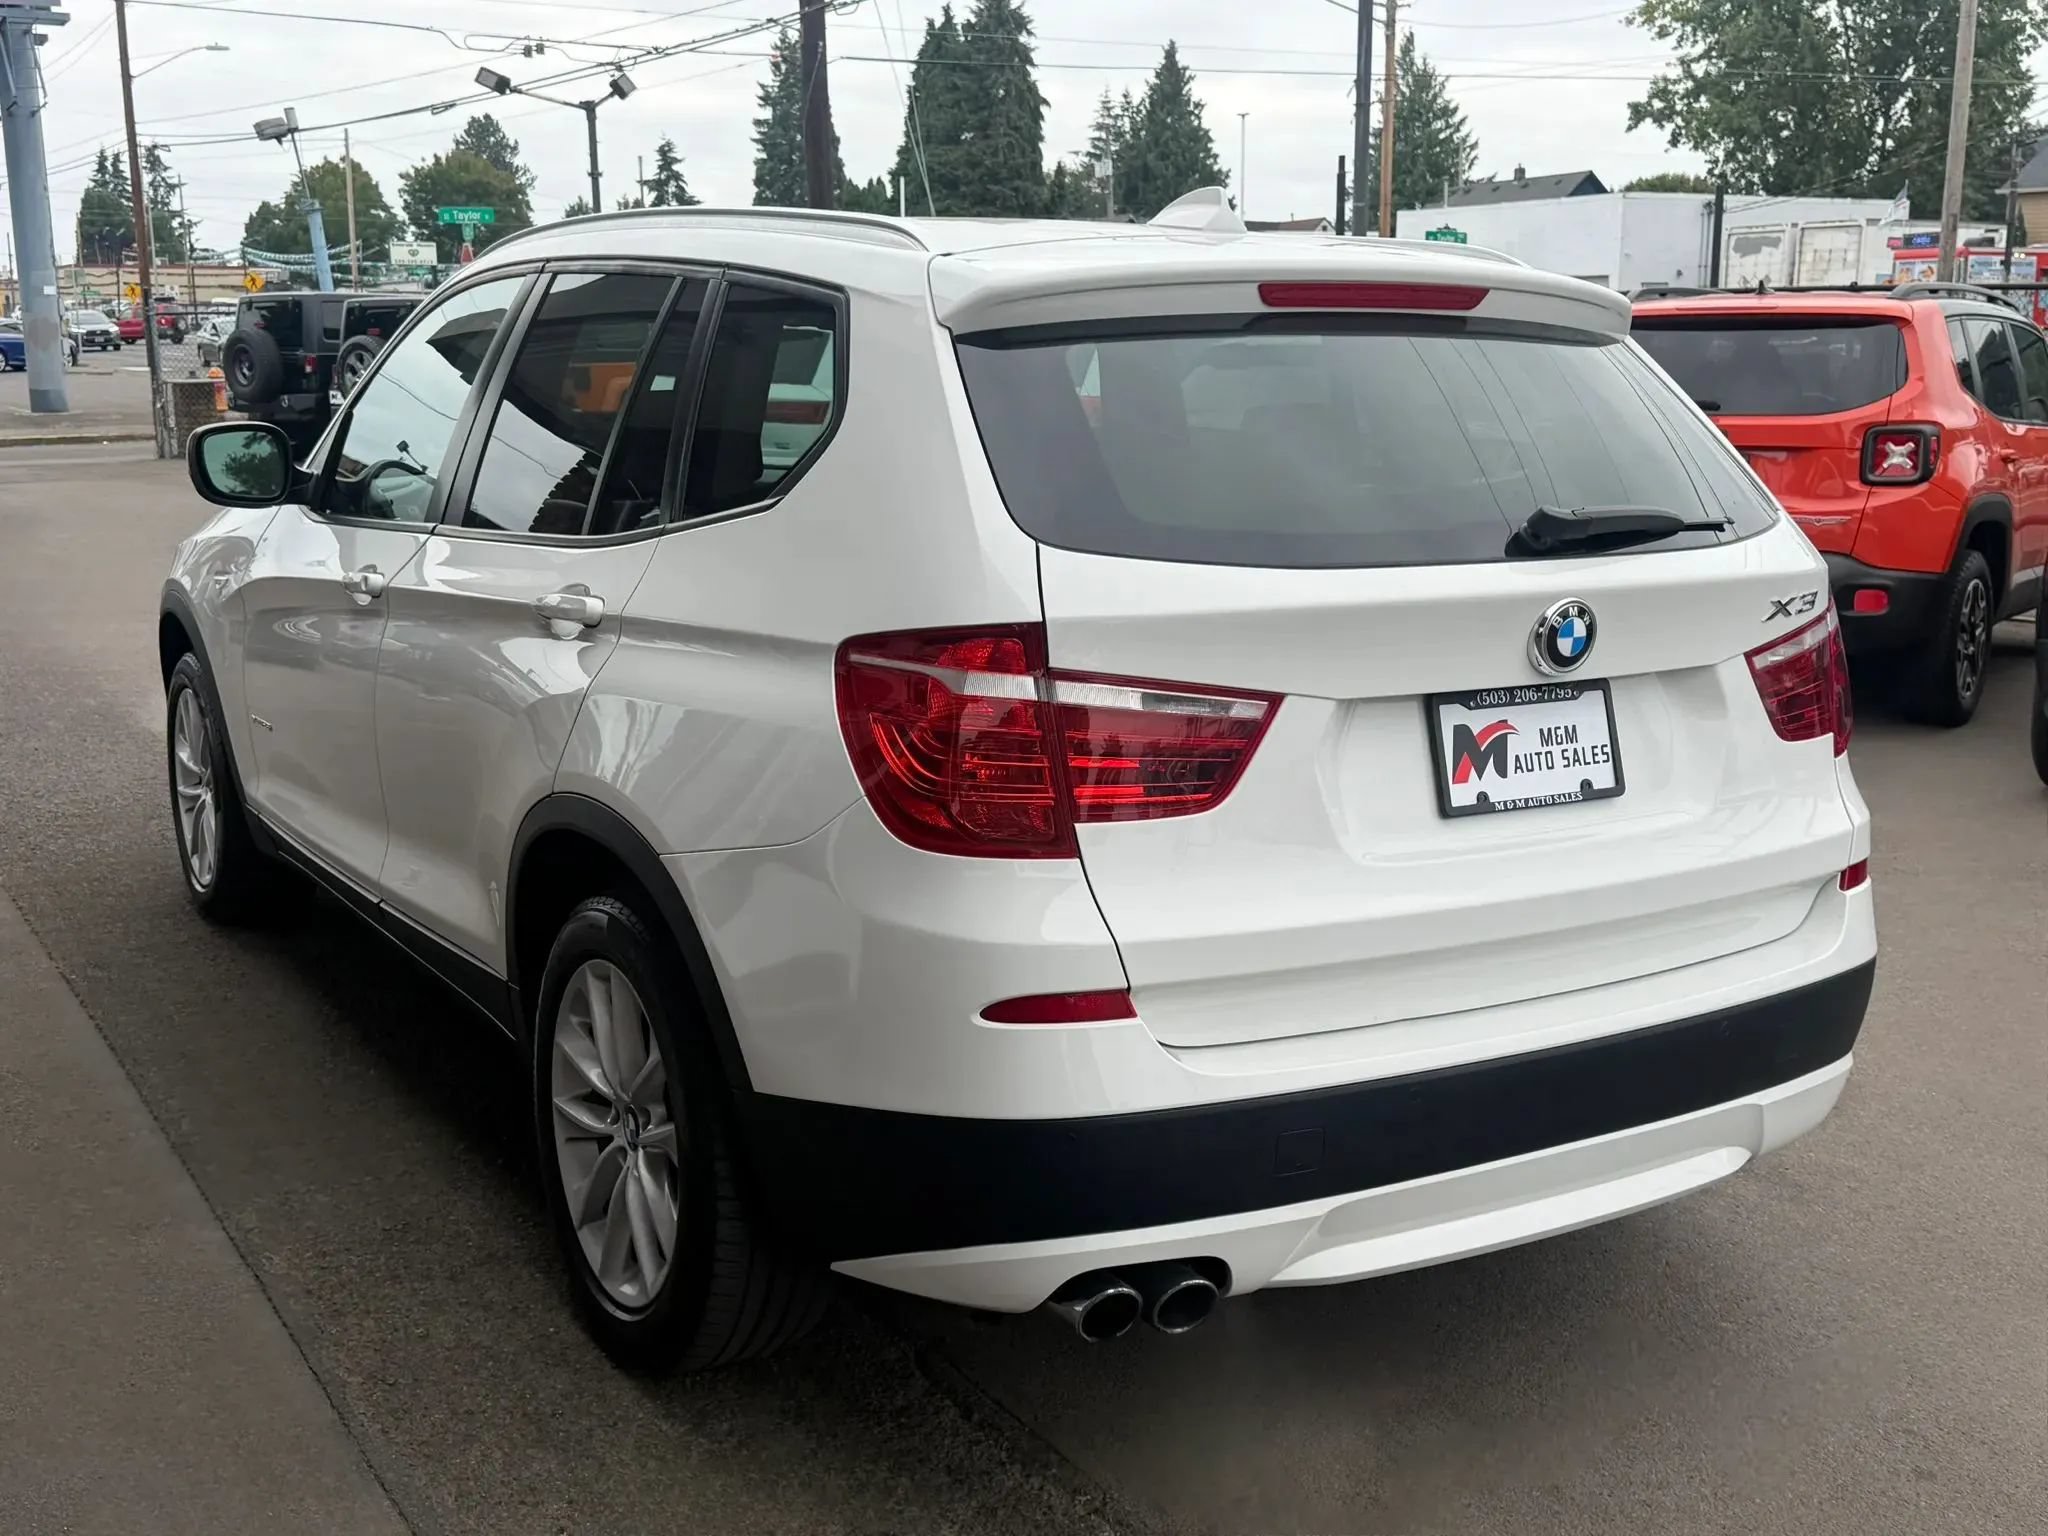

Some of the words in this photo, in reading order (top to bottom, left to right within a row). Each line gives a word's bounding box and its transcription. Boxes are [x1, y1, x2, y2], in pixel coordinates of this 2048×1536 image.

[452, 210, 481, 222] Taylor
[1761, 590, 1818, 622] X3
[1553, 607, 1591, 629] BMW
[1476, 689, 1510, 706] (503)
[1539, 724, 1579, 748] M&M
[1514, 751, 1555, 775] AUTO
[1563, 743, 1610, 768] SALES
[1494, 802, 1505, 811] M
[1515, 799, 1526, 808] M
[1528, 795, 1553, 807] AUTO
[1553, 792, 1583, 804] SALES
